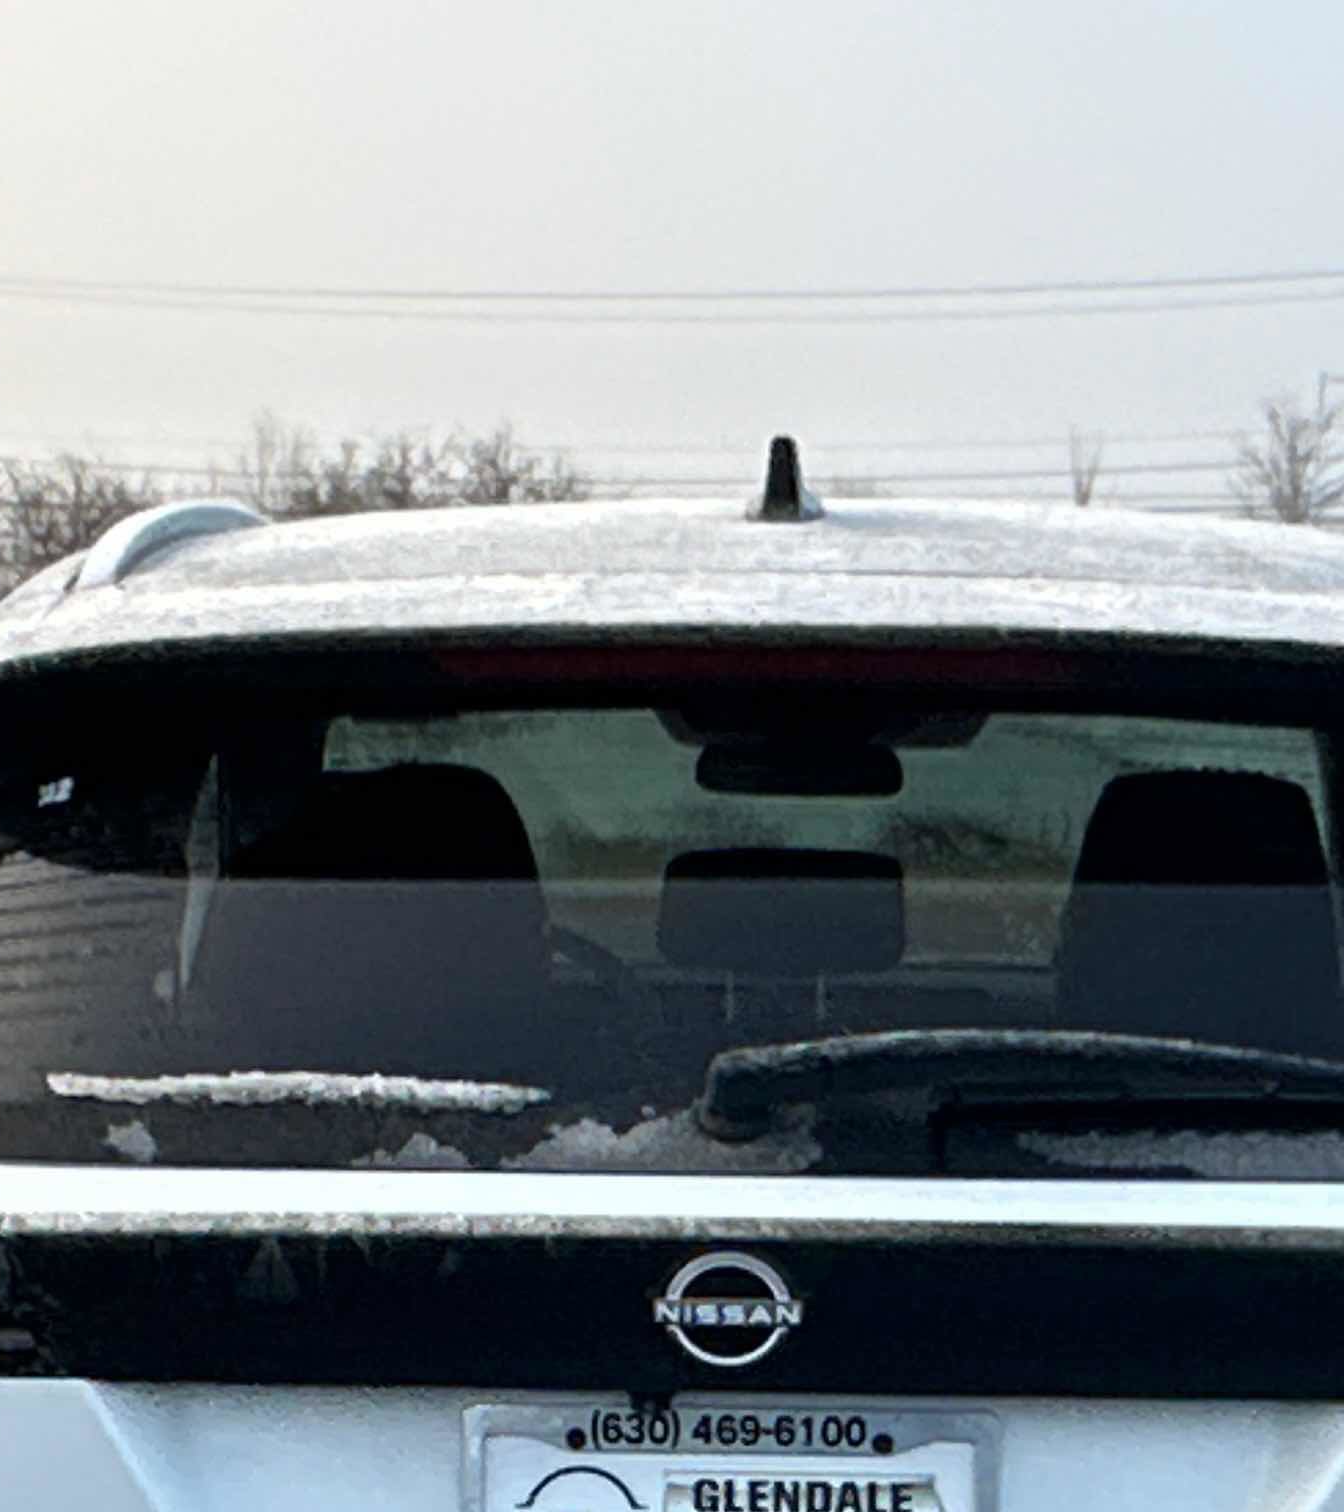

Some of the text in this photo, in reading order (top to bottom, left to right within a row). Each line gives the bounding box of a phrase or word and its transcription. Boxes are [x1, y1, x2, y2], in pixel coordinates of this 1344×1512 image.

[655, 1301, 802, 1326] NISSAN
[592, 1409, 867, 1450] (630) 469-6100
